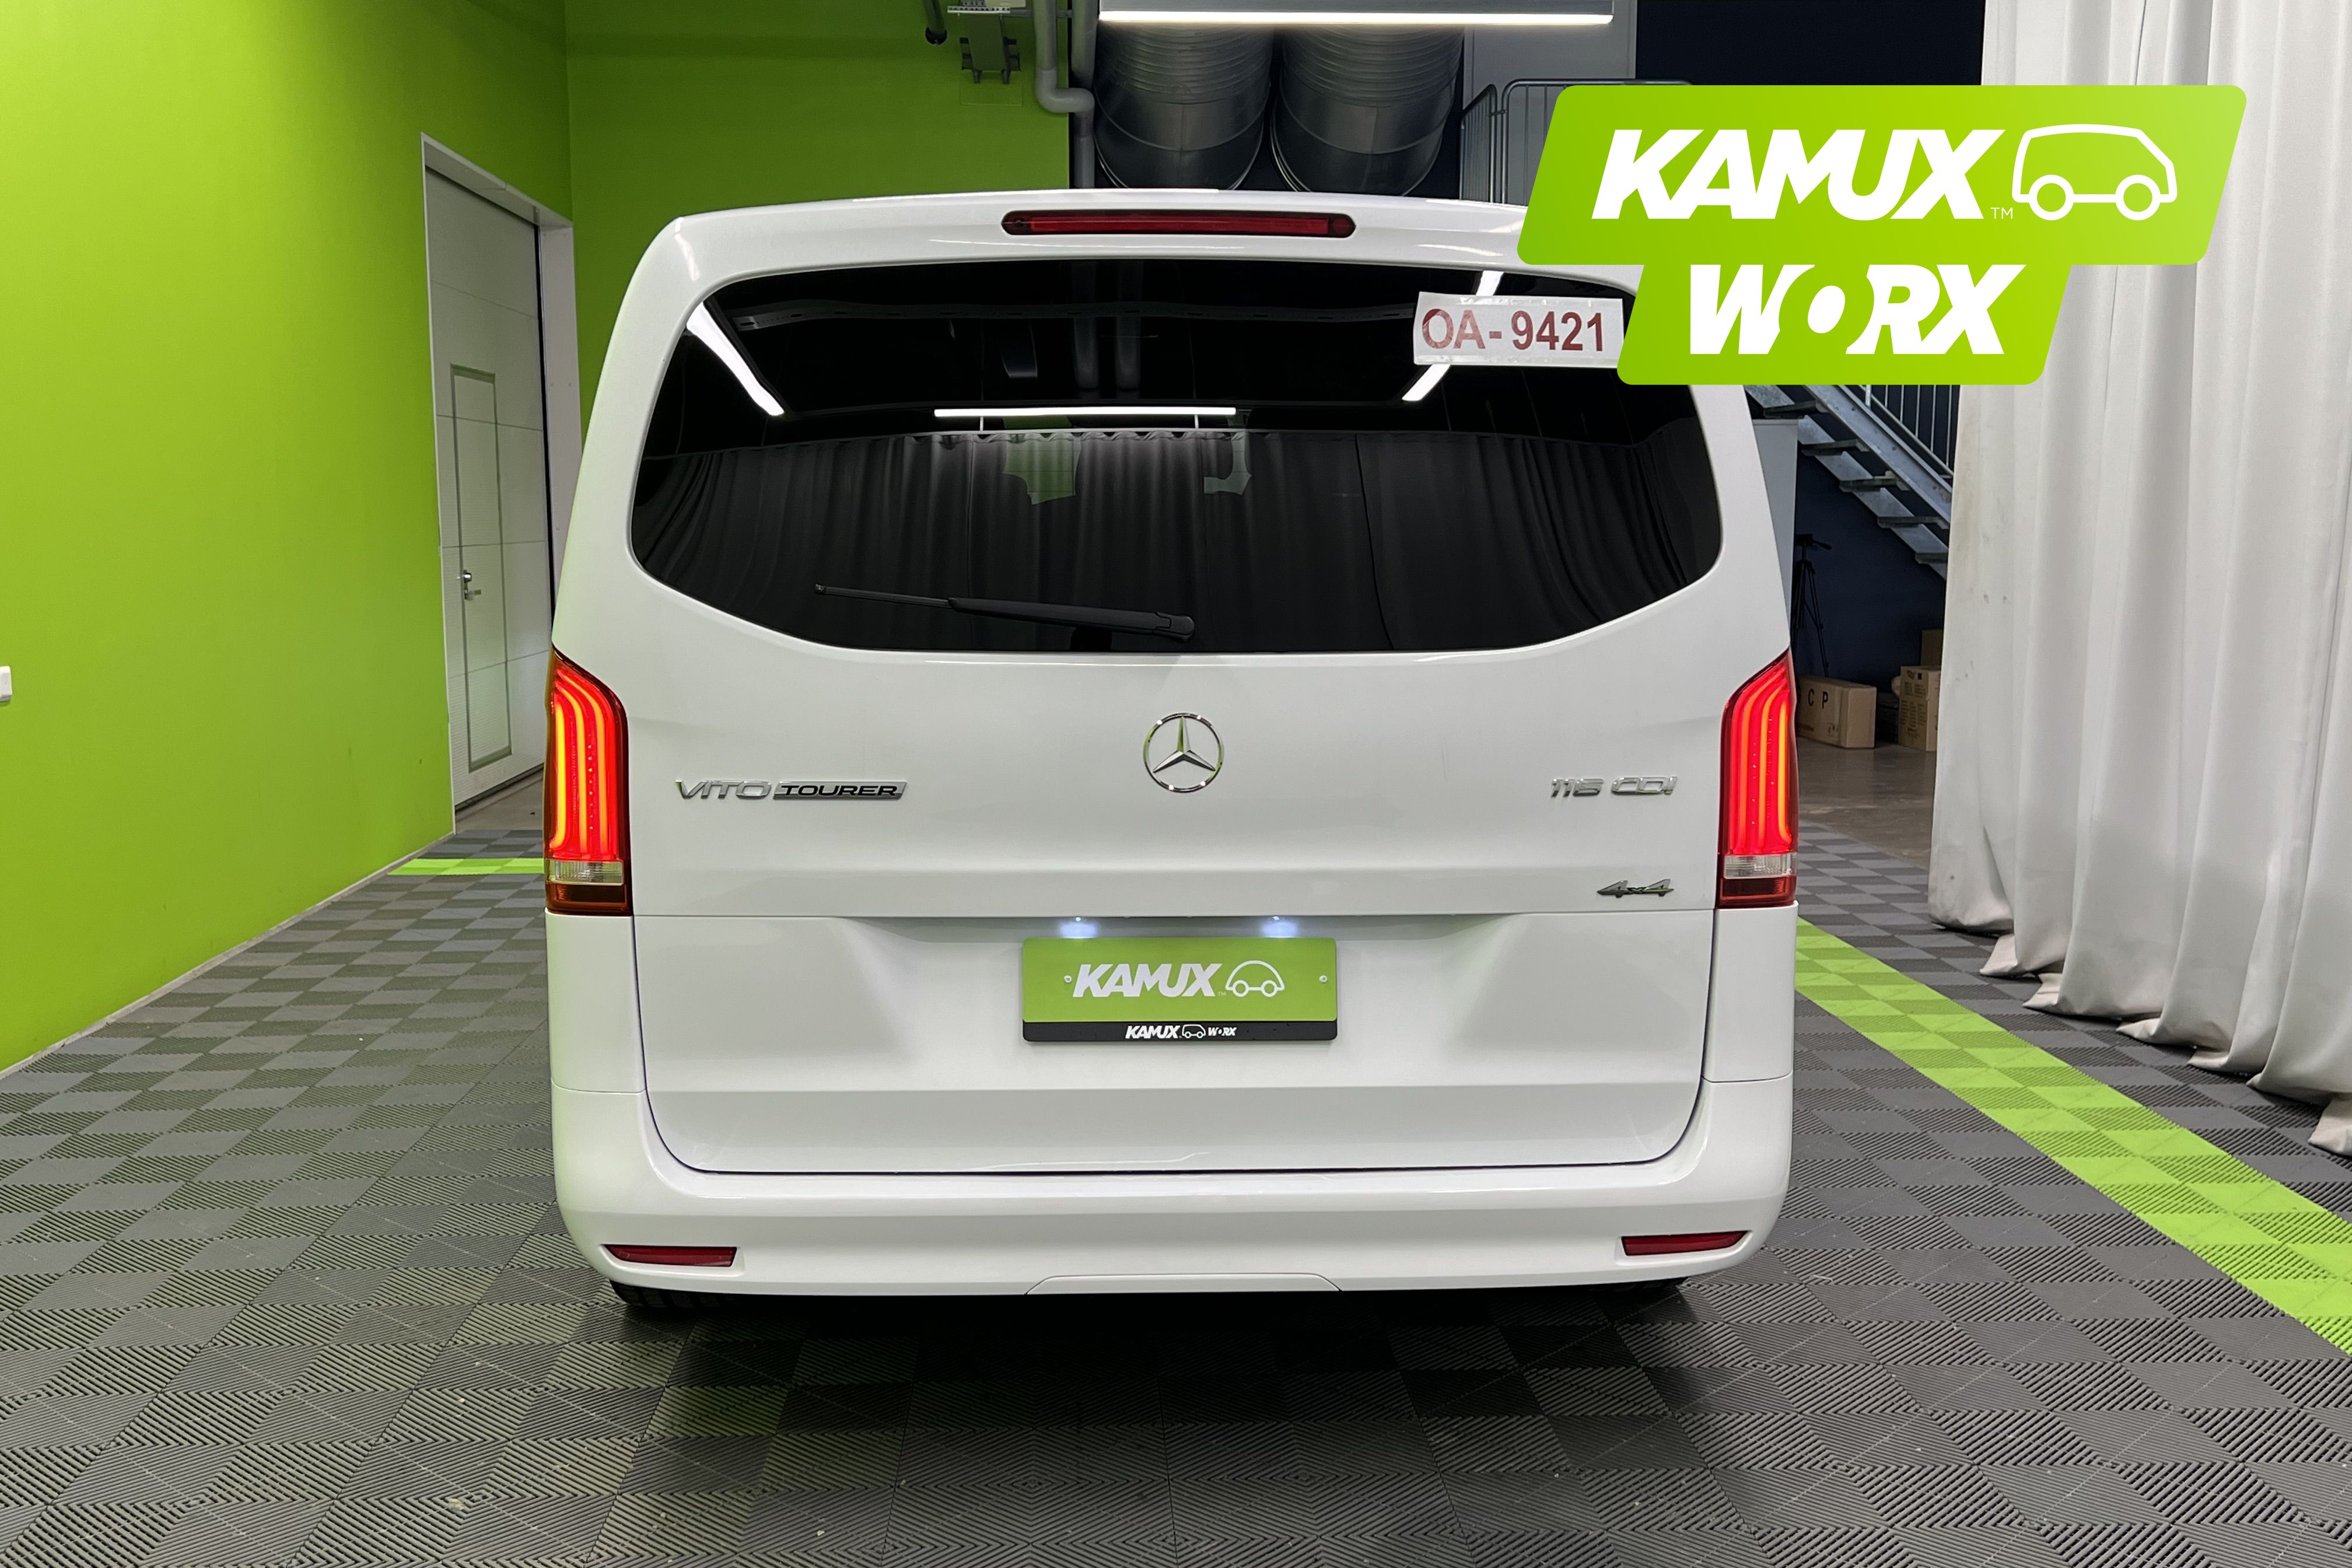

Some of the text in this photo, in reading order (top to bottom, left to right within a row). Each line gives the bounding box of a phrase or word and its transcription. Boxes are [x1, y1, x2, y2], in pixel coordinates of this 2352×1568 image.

[675, 779, 900, 800] VITO TOURER
[1611, 775, 1678, 796] CDI
[1072, 963, 1222, 998] KAMUX
[1125, 1025, 1237, 1039] KAMUX WORX
